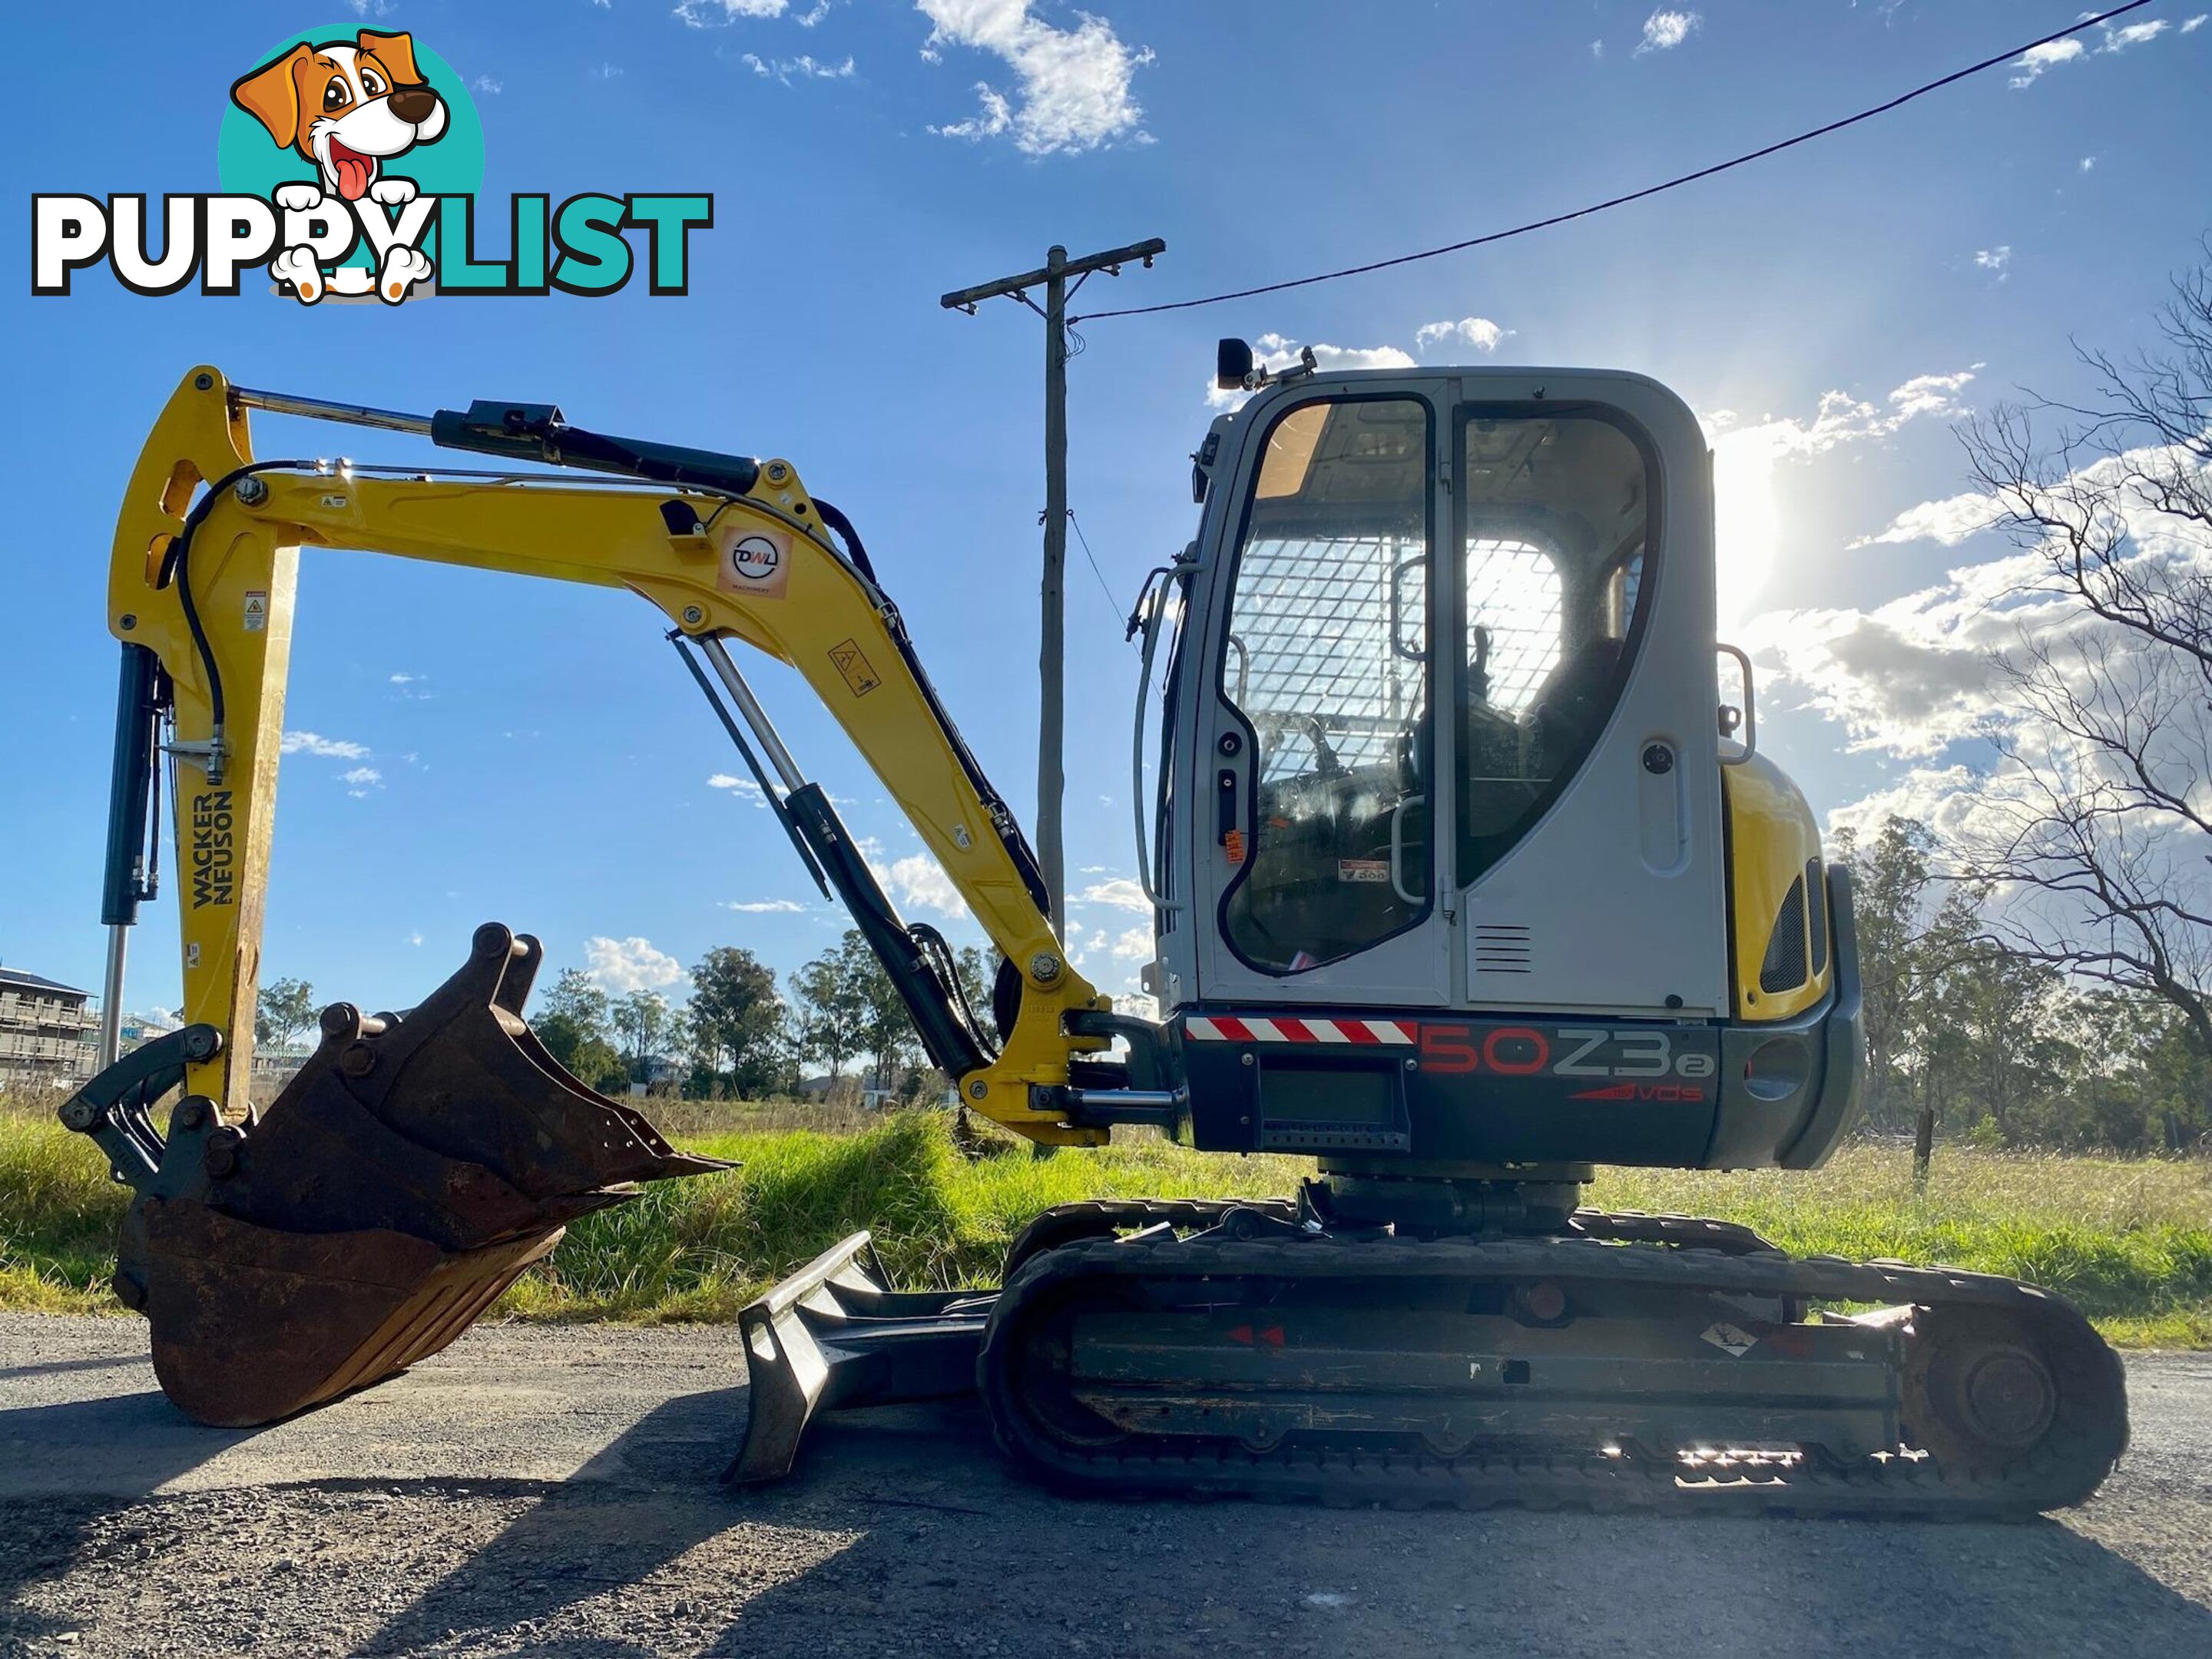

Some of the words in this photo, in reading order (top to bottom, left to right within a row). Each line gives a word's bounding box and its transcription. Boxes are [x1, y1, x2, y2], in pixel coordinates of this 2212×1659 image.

[737, 549, 777, 565] DWL
[194, 792, 213, 910] WACKER
[214, 791, 233, 905] NEUSON
